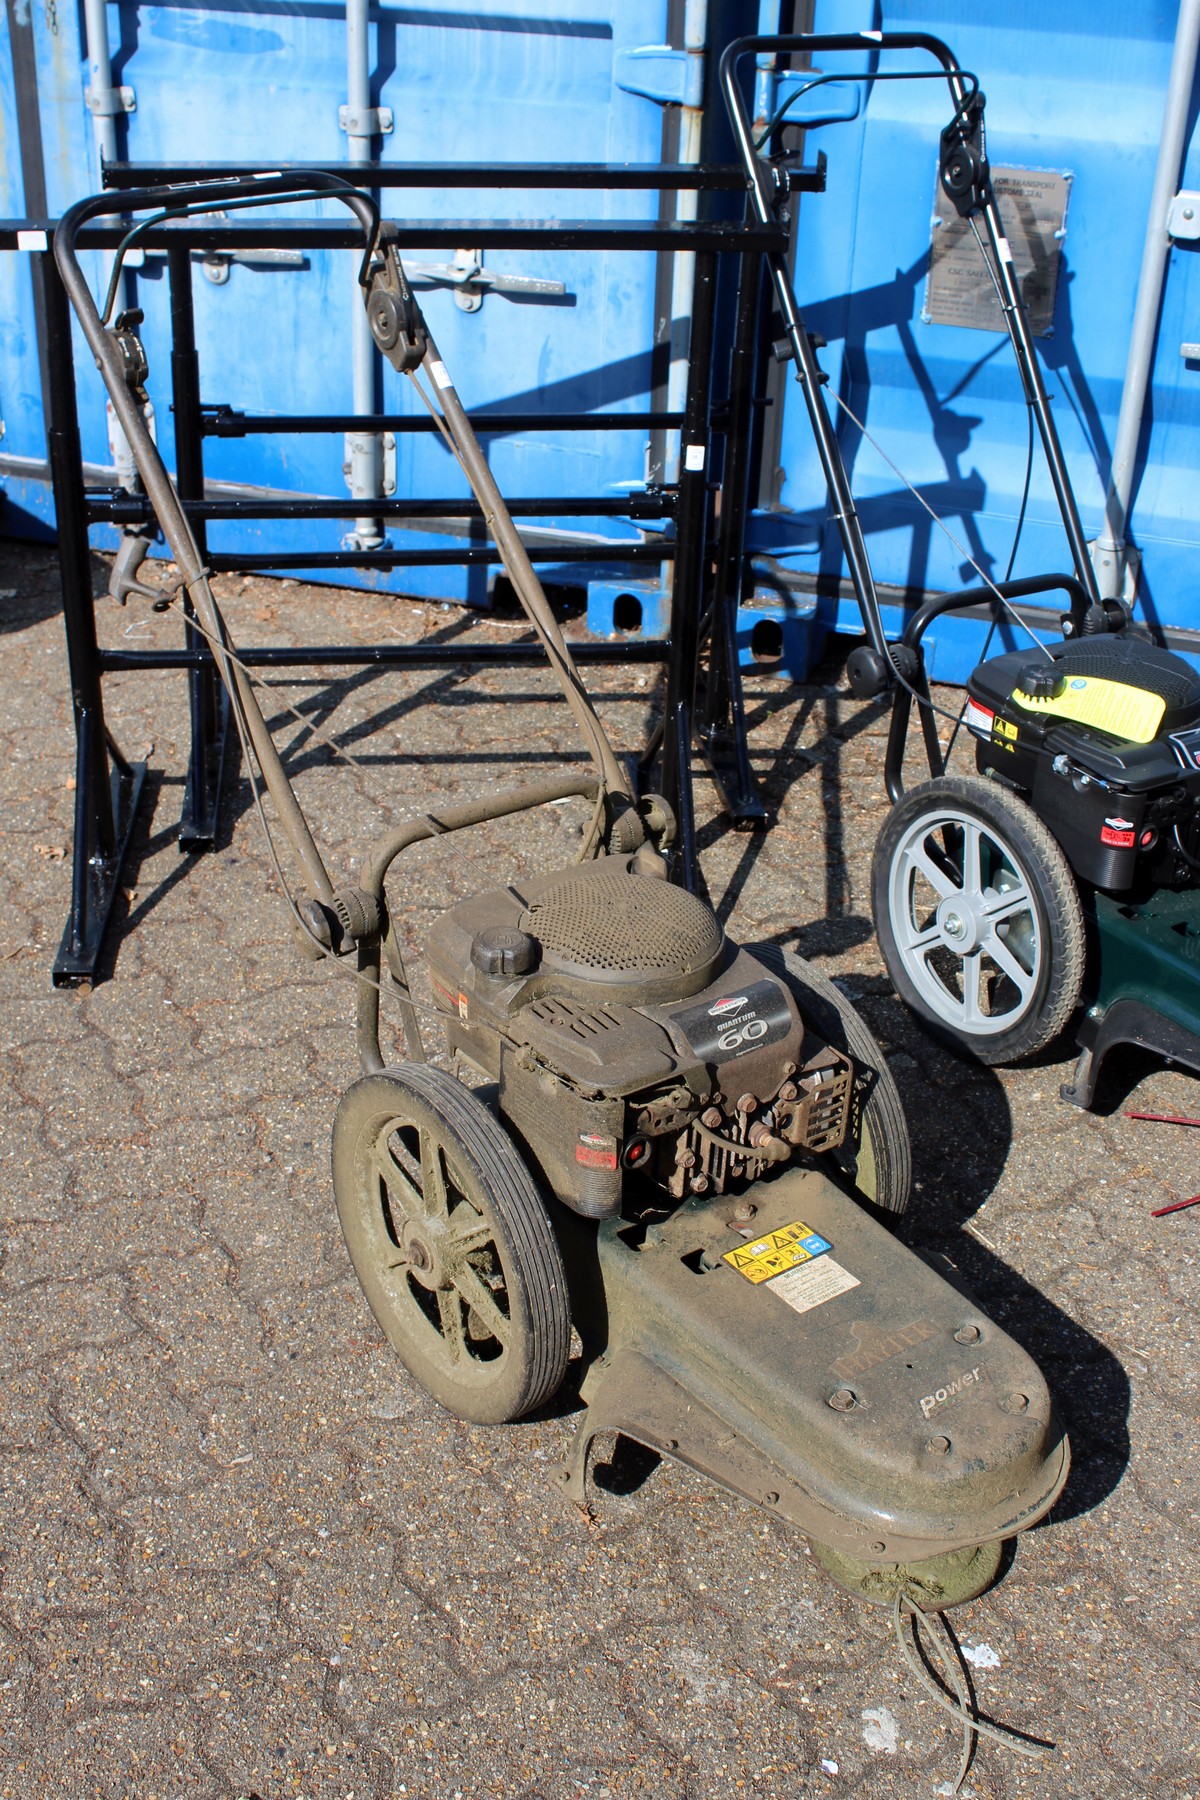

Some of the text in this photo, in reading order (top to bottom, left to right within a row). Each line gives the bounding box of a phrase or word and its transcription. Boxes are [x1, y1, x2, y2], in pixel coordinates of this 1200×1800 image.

[1013, 179, 1056, 190] TRANSPORT
[992, 187, 1043, 199] USTOMS SEAL
[967, 269, 989, 278] SAFET
[716, 1011, 756, 1031] QUANTUM
[717, 1019, 768, 1051] 60
[919, 1366, 982, 1419] power
